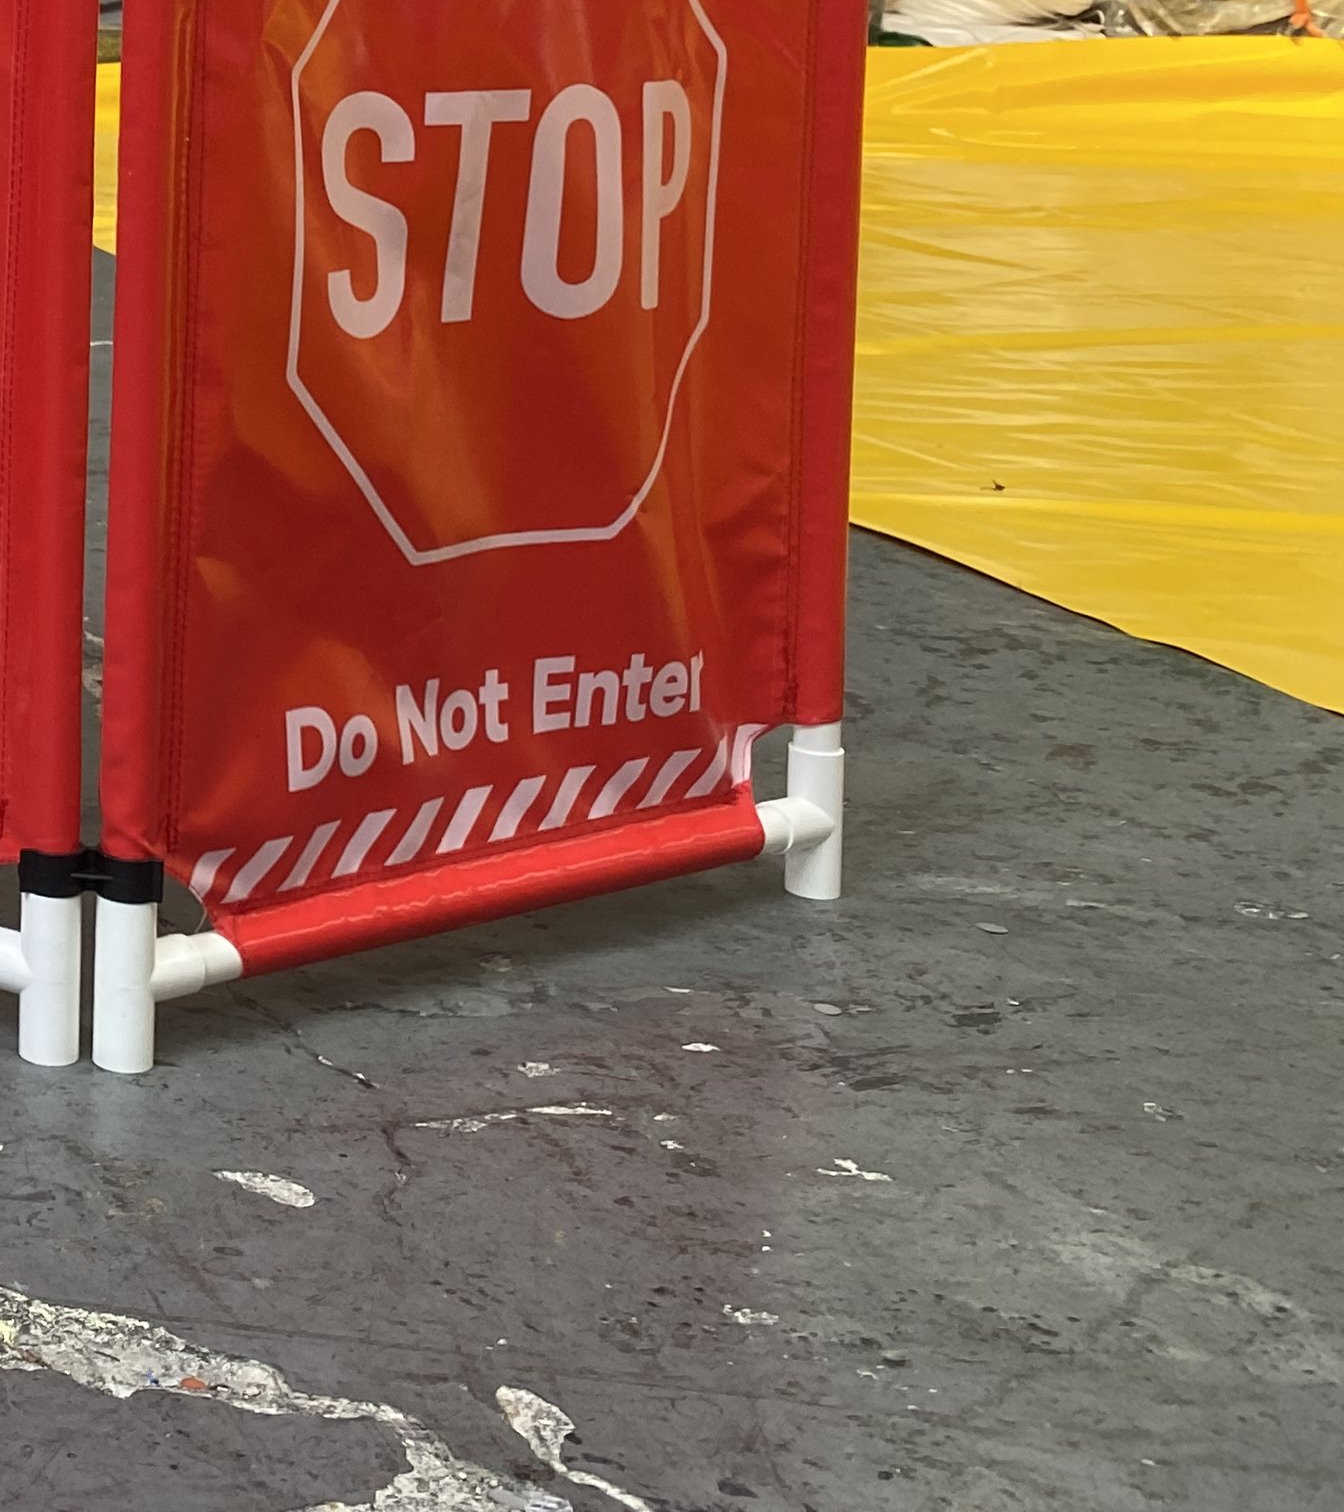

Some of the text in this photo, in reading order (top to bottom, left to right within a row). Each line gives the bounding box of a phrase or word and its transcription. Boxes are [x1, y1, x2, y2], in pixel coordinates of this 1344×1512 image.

[321, 79, 692, 339] STOP
[285, 649, 705, 792] Do Not Enter
